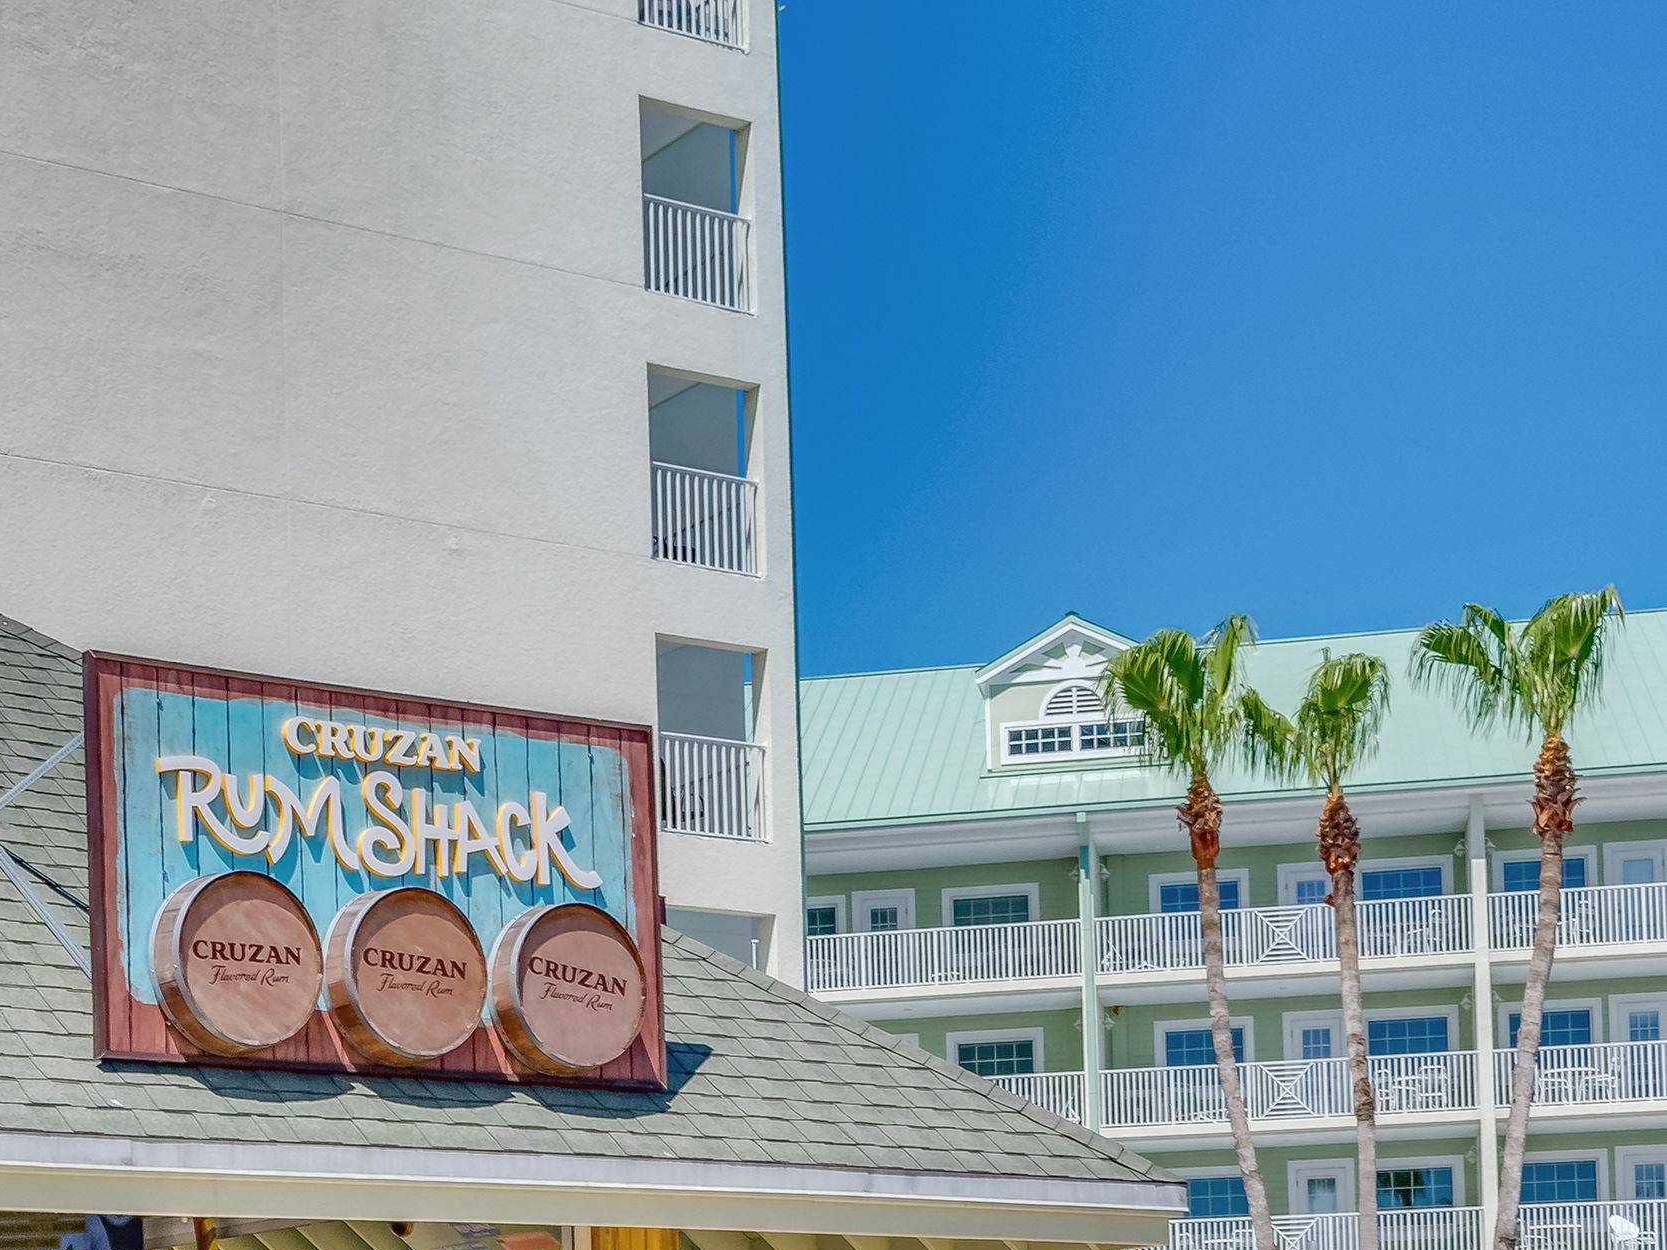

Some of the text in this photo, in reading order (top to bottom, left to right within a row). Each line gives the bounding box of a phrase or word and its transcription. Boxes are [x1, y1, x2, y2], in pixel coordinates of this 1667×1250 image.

[281, 715, 482, 774] CRUZAN
[155, 754, 605, 890] RUM SHACK
[192, 940, 302, 966] CRUZAN
[362, 947, 468, 980] CRUZAN
[209, 965, 289, 986] Flavored Rum
[376, 973, 454, 998] Flavored Rum
[528, 956, 628, 997] CRUZAN
[540, 982, 614, 1012] Flavored Rum
